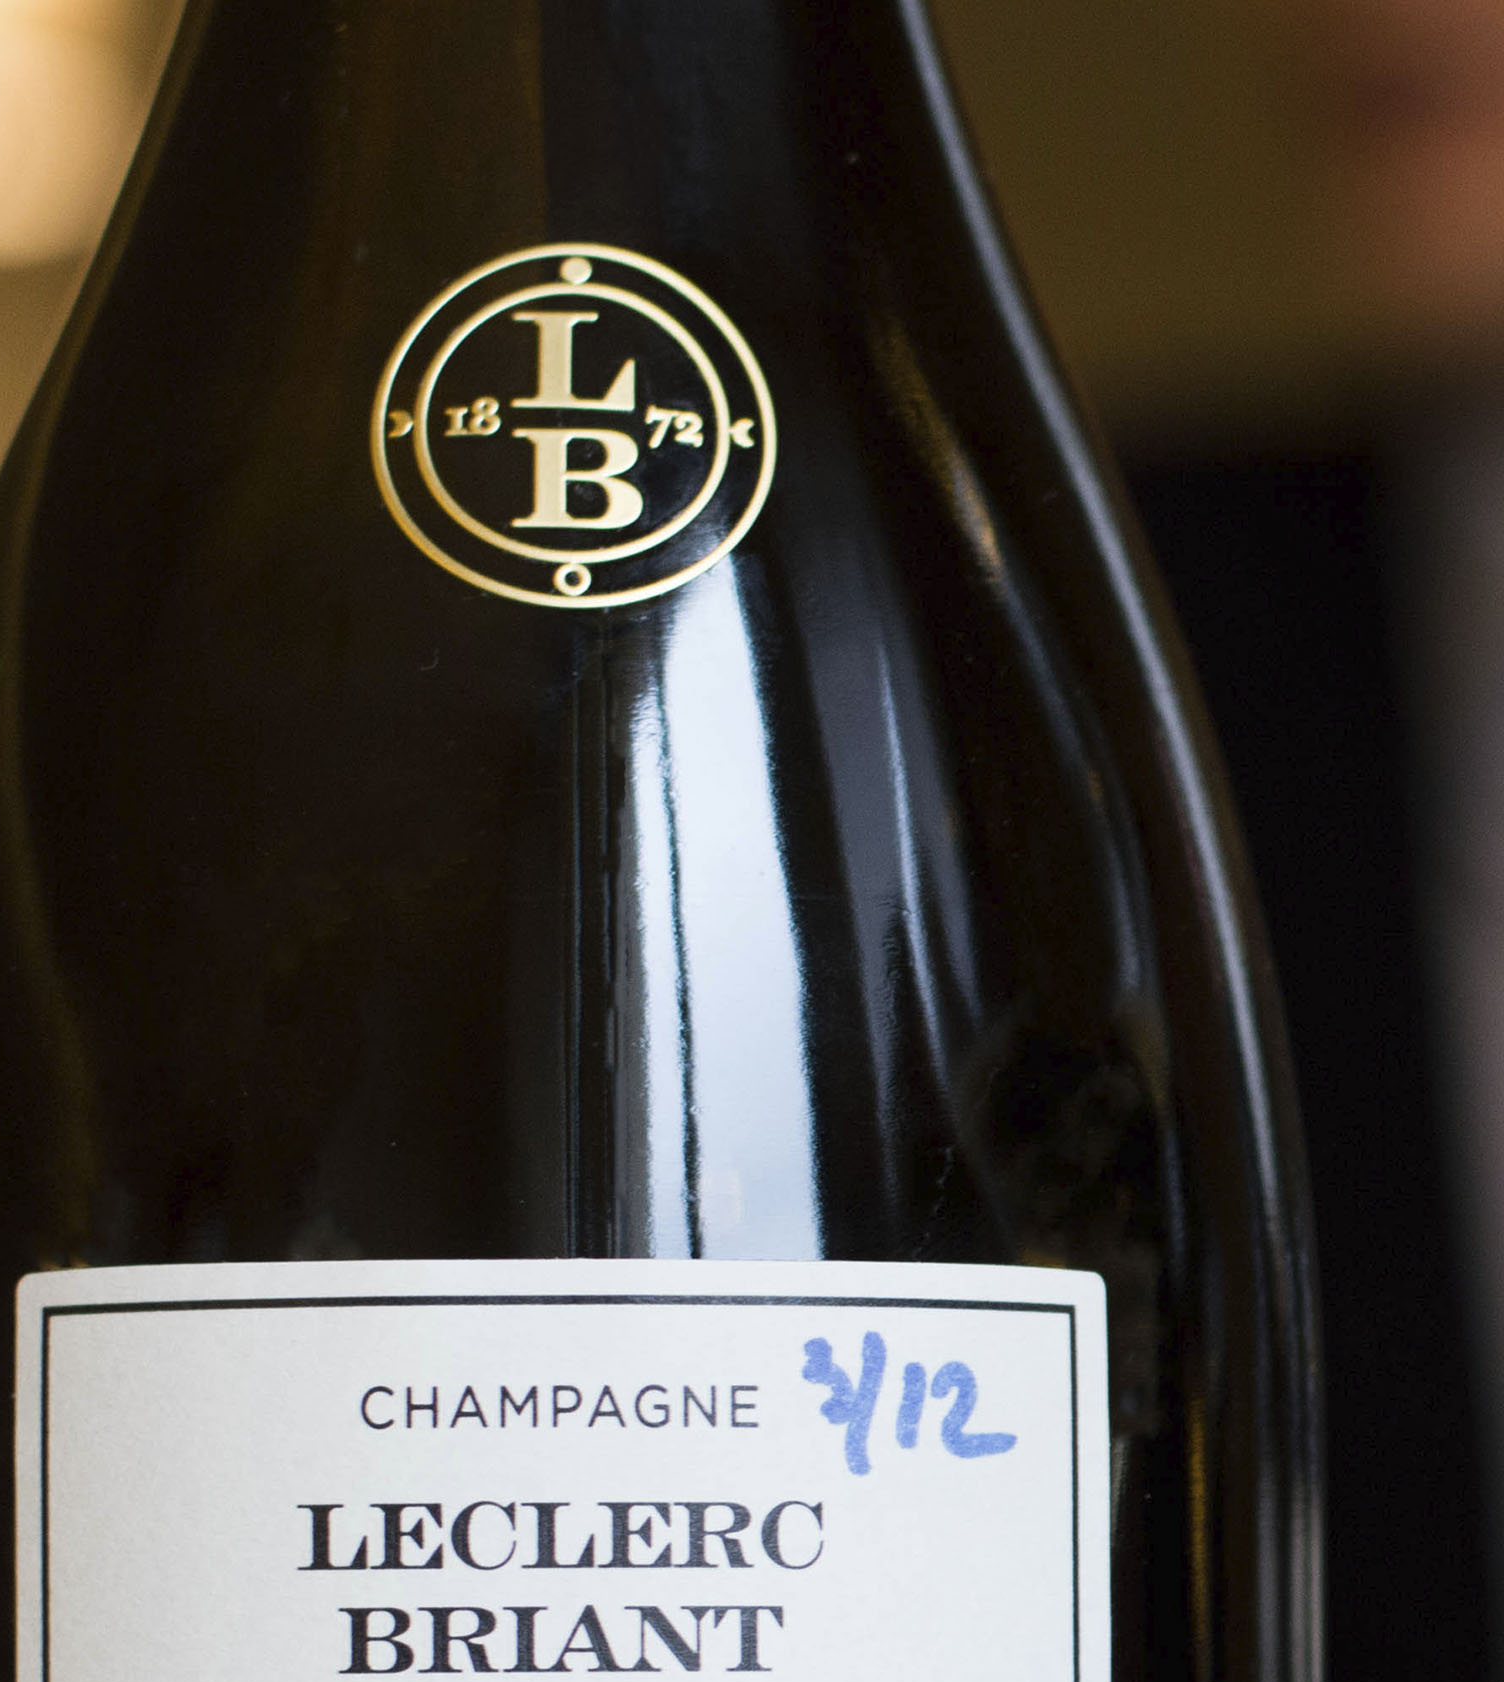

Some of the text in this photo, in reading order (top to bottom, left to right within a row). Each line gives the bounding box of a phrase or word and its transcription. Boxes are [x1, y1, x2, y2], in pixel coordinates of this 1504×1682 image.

[510, 309, 635, 411] L
[443, 396, 704, 449] 18 72
[510, 427, 643, 530] B
[359, 1384, 760, 1431] CHAMPAGNE
[296, 1500, 824, 1571] LECLERC
[337, 1604, 784, 1675] BRIANT
